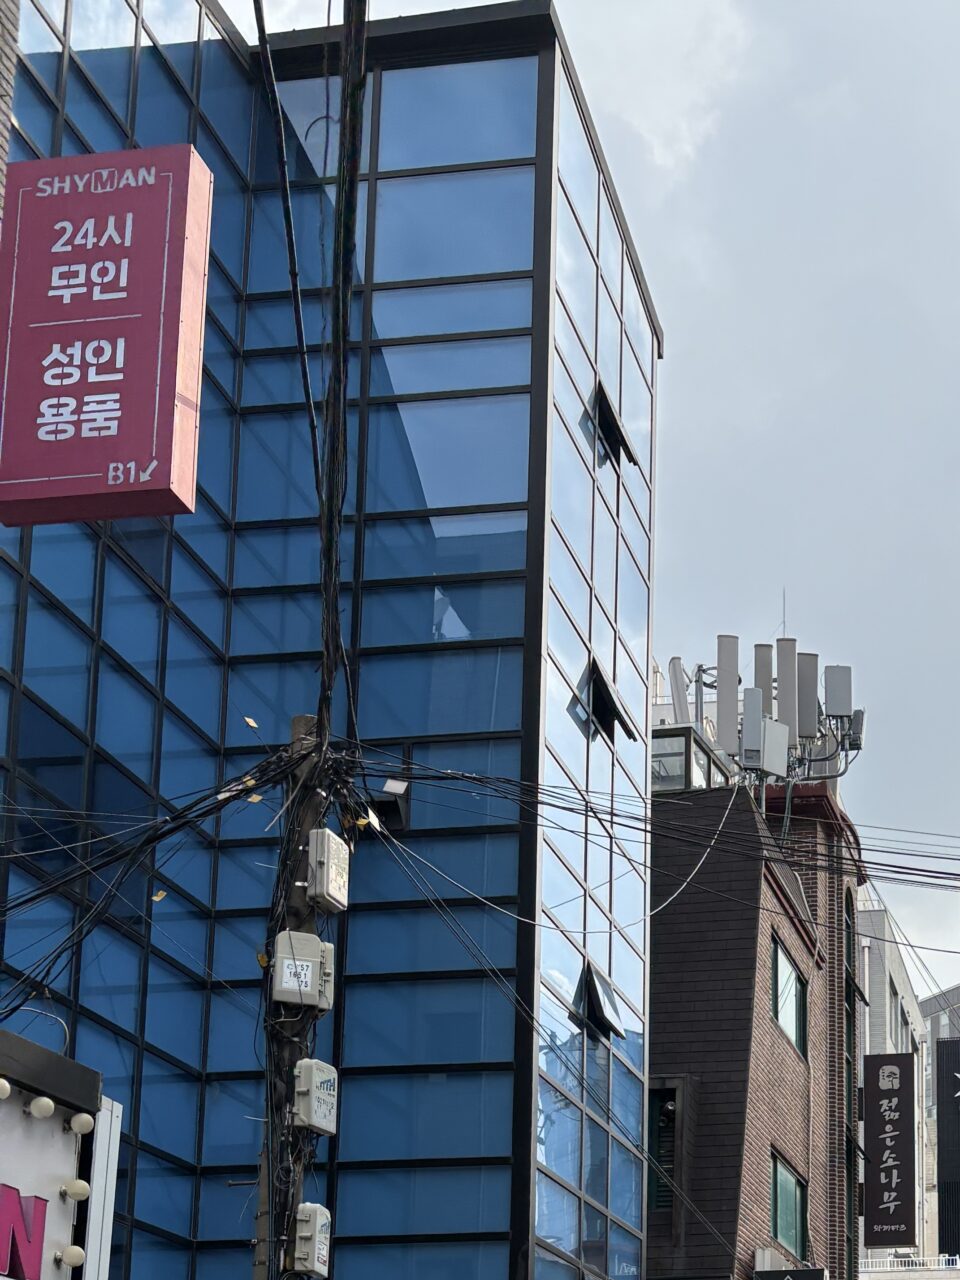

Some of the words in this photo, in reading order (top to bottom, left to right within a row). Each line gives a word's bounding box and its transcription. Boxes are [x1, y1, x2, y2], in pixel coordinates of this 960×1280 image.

[35, 166, 156, 197] SHYMAN
[51, 212, 133, 253] 24시
[47, 258, 128, 304] 무인
[41, 337, 125, 386] 성인
[36, 392, 122, 442] 용품
[107, 460, 136, 486] B1
[879, 1097, 902, 1214] 젊은소나무
